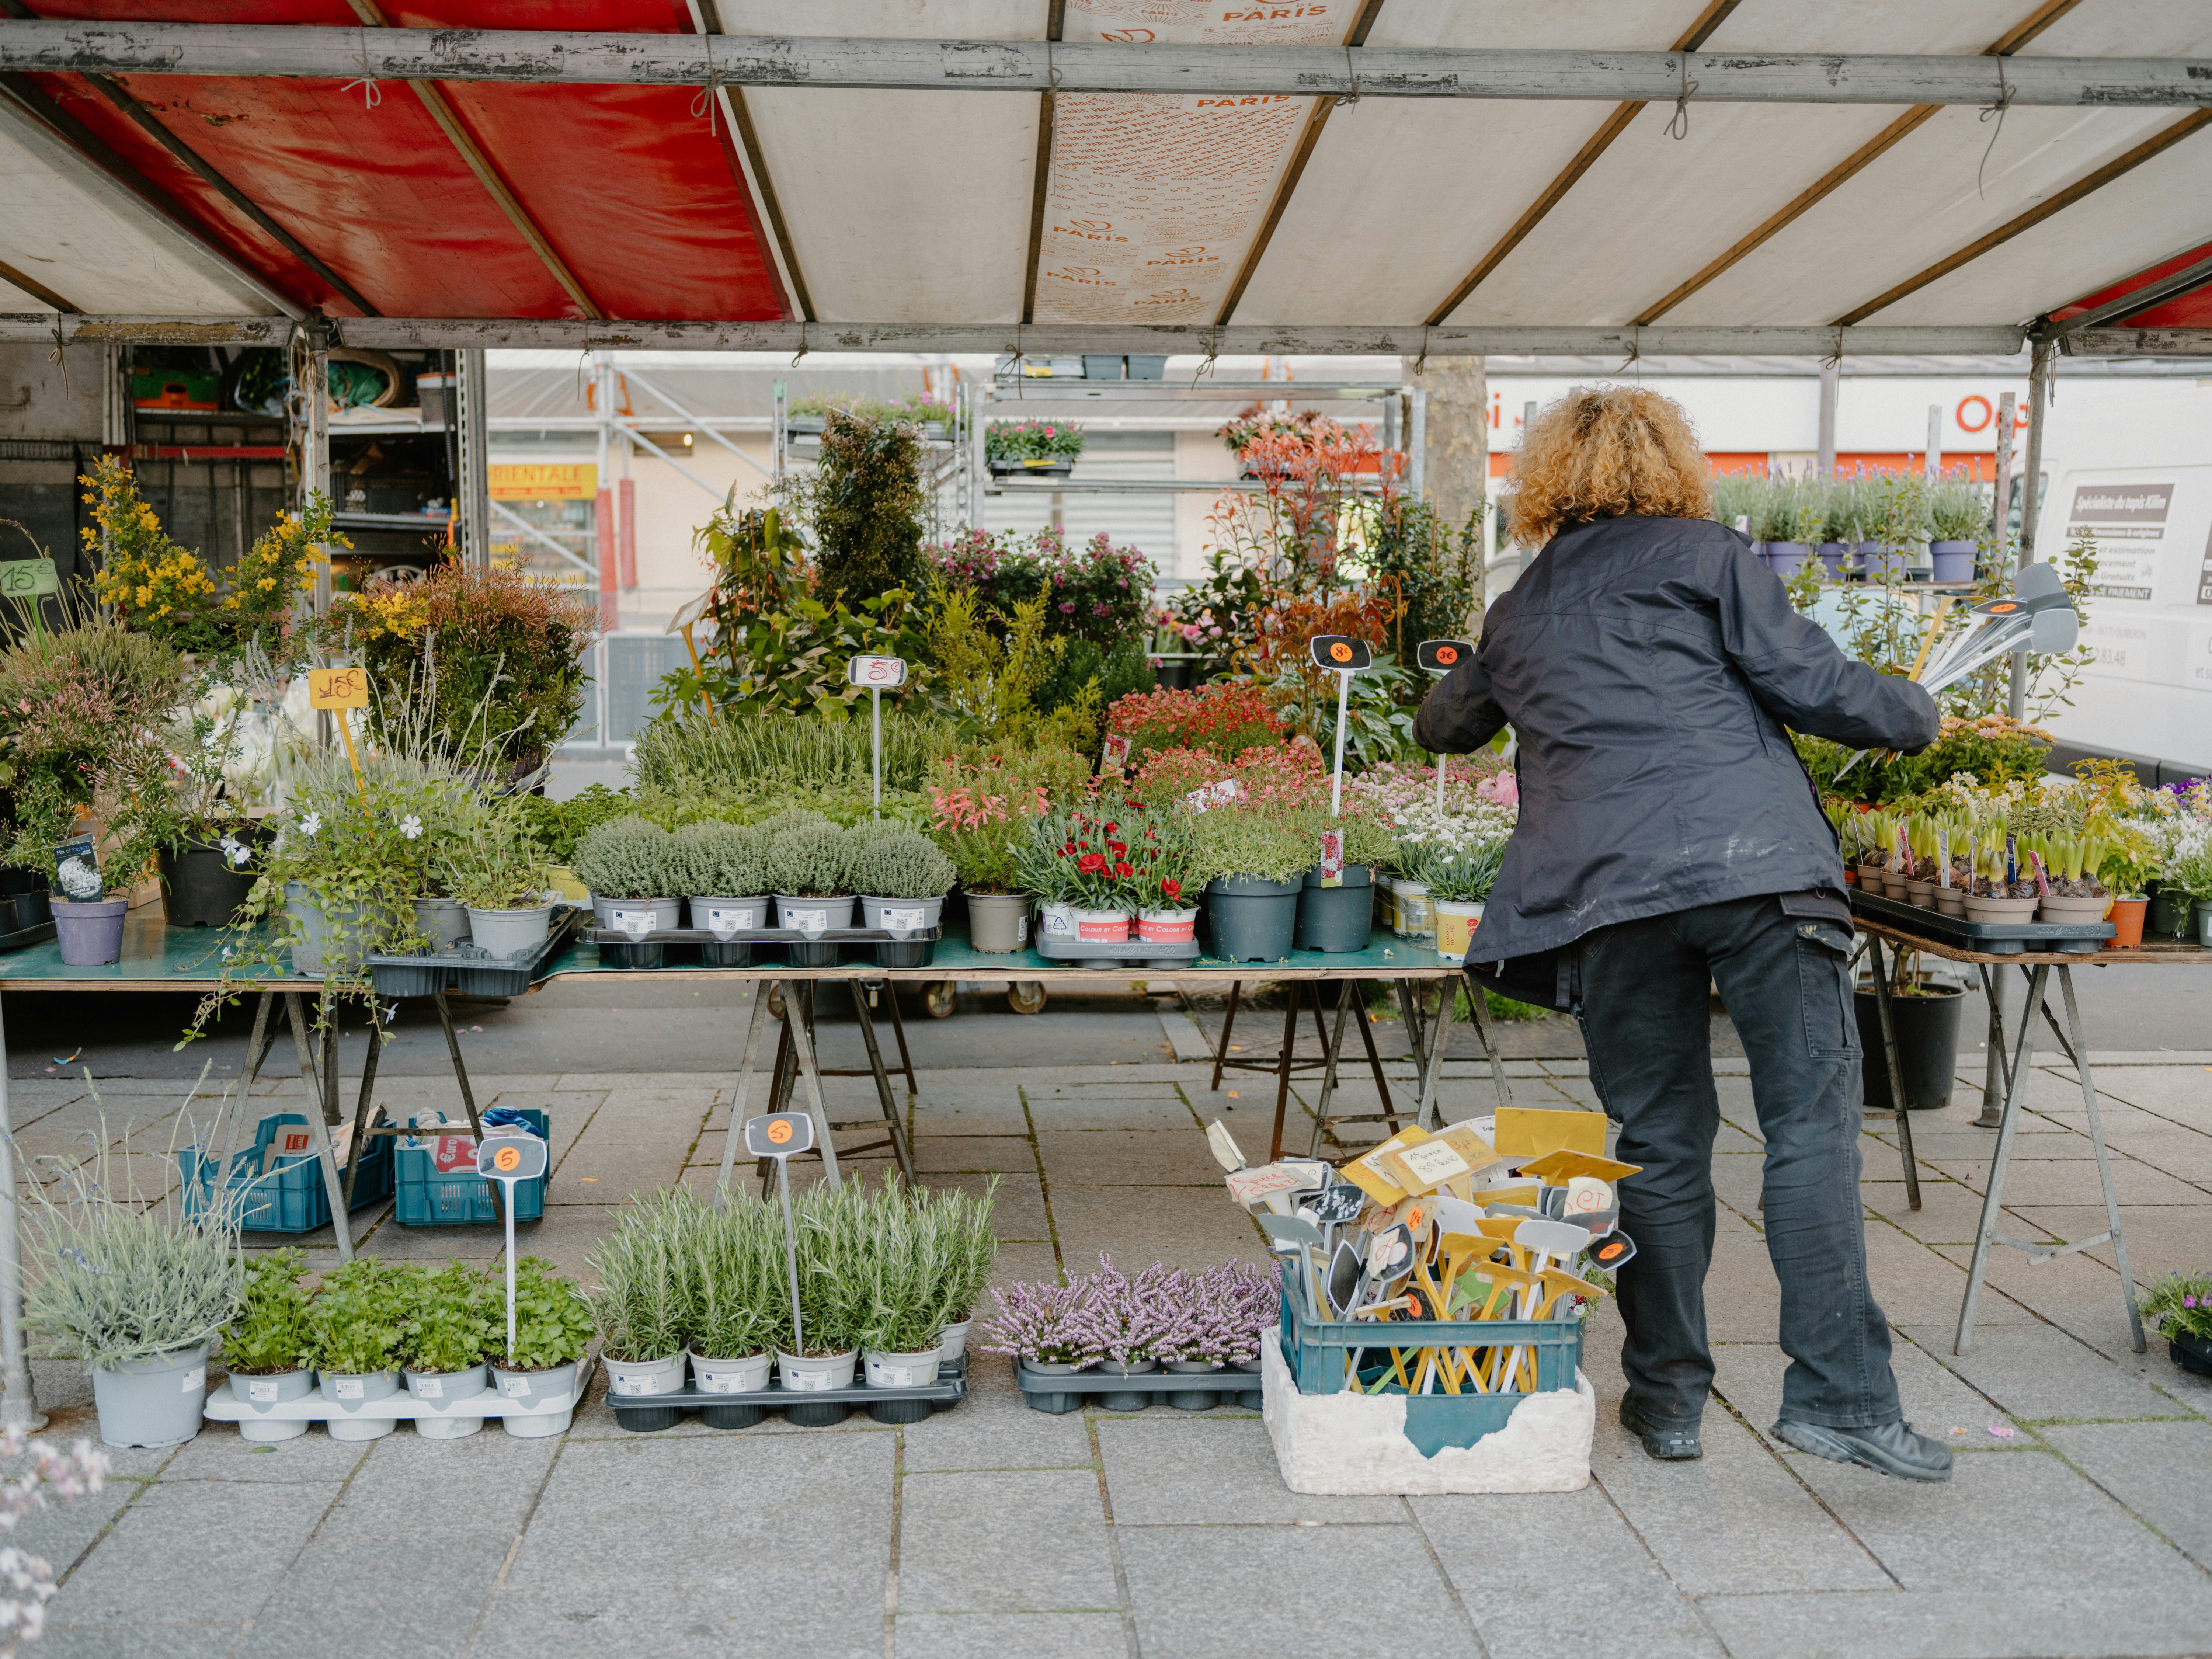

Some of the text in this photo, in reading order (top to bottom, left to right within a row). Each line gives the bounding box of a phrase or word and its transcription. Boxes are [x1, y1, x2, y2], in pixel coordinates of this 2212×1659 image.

[1223, 6, 1328, 21] PARIS
[1197, 95, 1290, 107] PARIS
[1054, 226, 1129, 242] PARIS
[1147, 256, 1220, 265] PARIS
[1047, 272, 1116, 286] PARIS
[1134, 297, 1201, 305] PARIS
[1336, 646, 1348, 657] 8€
[1439, 651, 1453, 660] 3€
[70, 887, 91, 895] JASMINUM
[2084, 926, 2101, 936] 480
[1158, 945, 1176, 956] 422
[296, 1135, 305, 1149] LAVAL
[501, 1150, 514, 1166] 5
